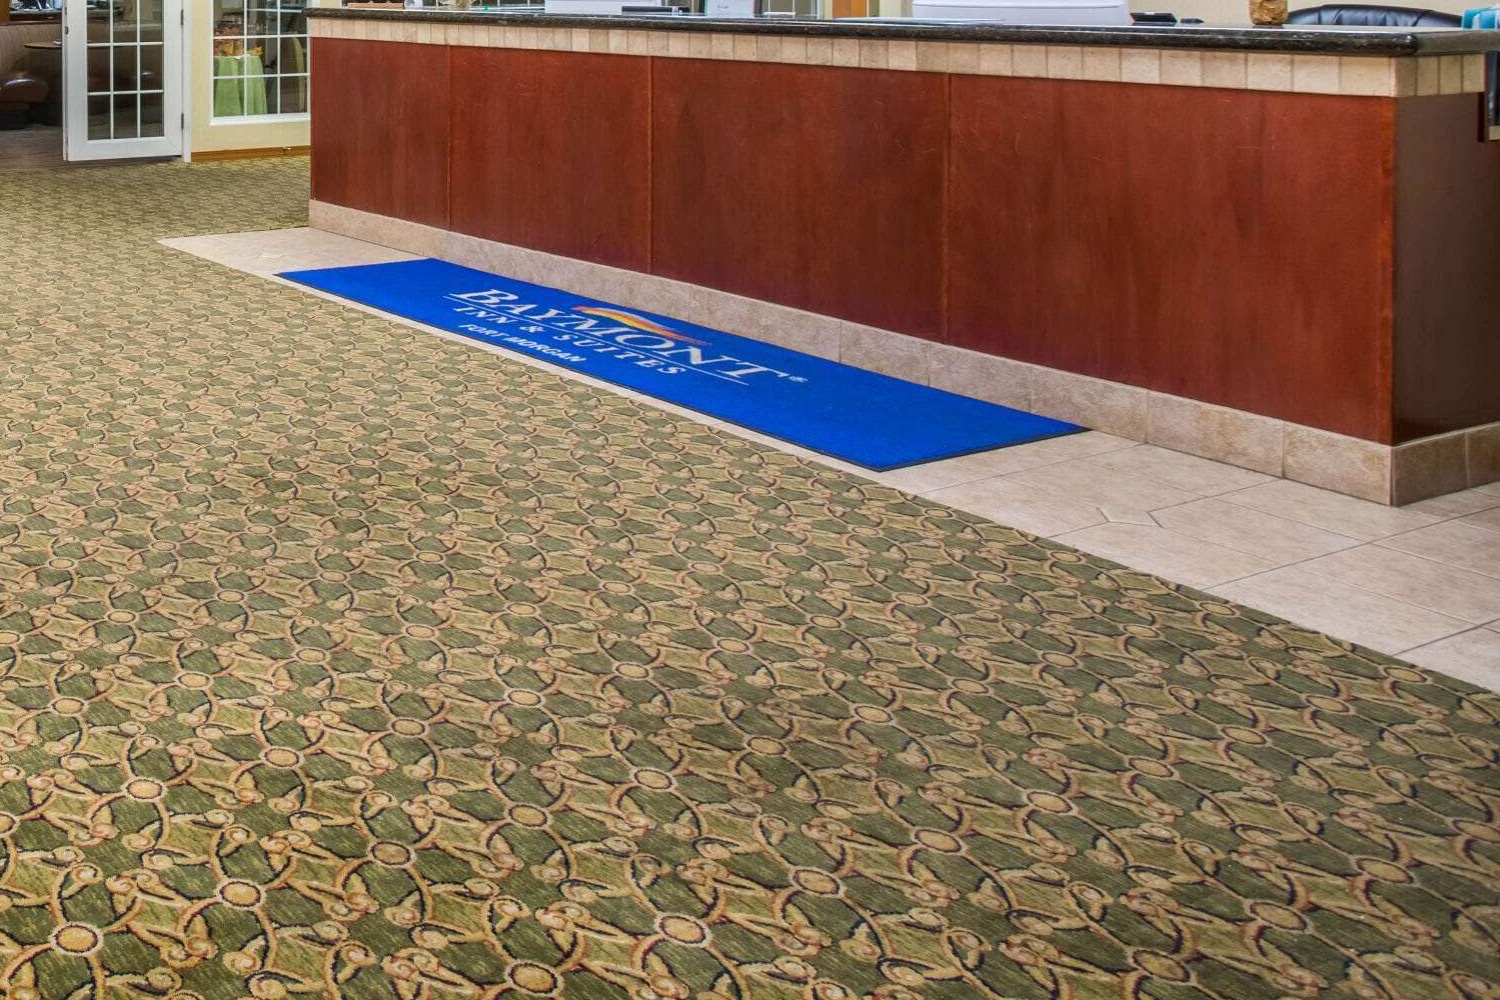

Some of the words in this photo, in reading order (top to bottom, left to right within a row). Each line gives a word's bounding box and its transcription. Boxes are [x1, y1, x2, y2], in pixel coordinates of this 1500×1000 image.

[453, 306, 520, 325] INN
[519, 325, 546, 334] &
[552, 334, 687, 375] SUITES
[458, 323, 513, 338] FORT
[512, 336, 588, 363] MORGAN
